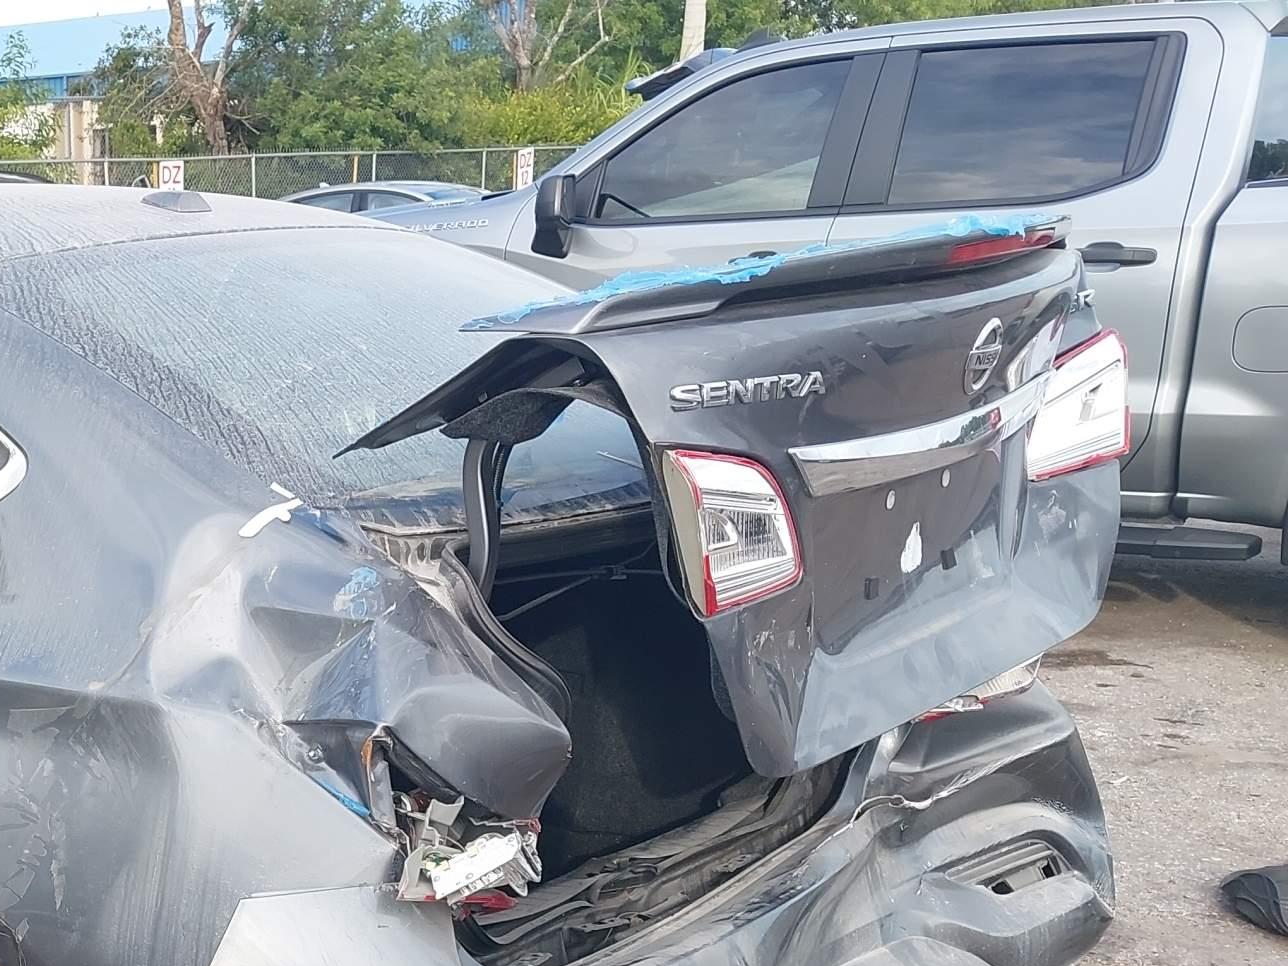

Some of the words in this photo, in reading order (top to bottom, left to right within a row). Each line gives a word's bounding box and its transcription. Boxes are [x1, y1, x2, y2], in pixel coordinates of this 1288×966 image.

[520, 151, 532, 169] DZ
[162, 165, 181, 184] DZ
[669, 370, 827, 413] SENTRA
